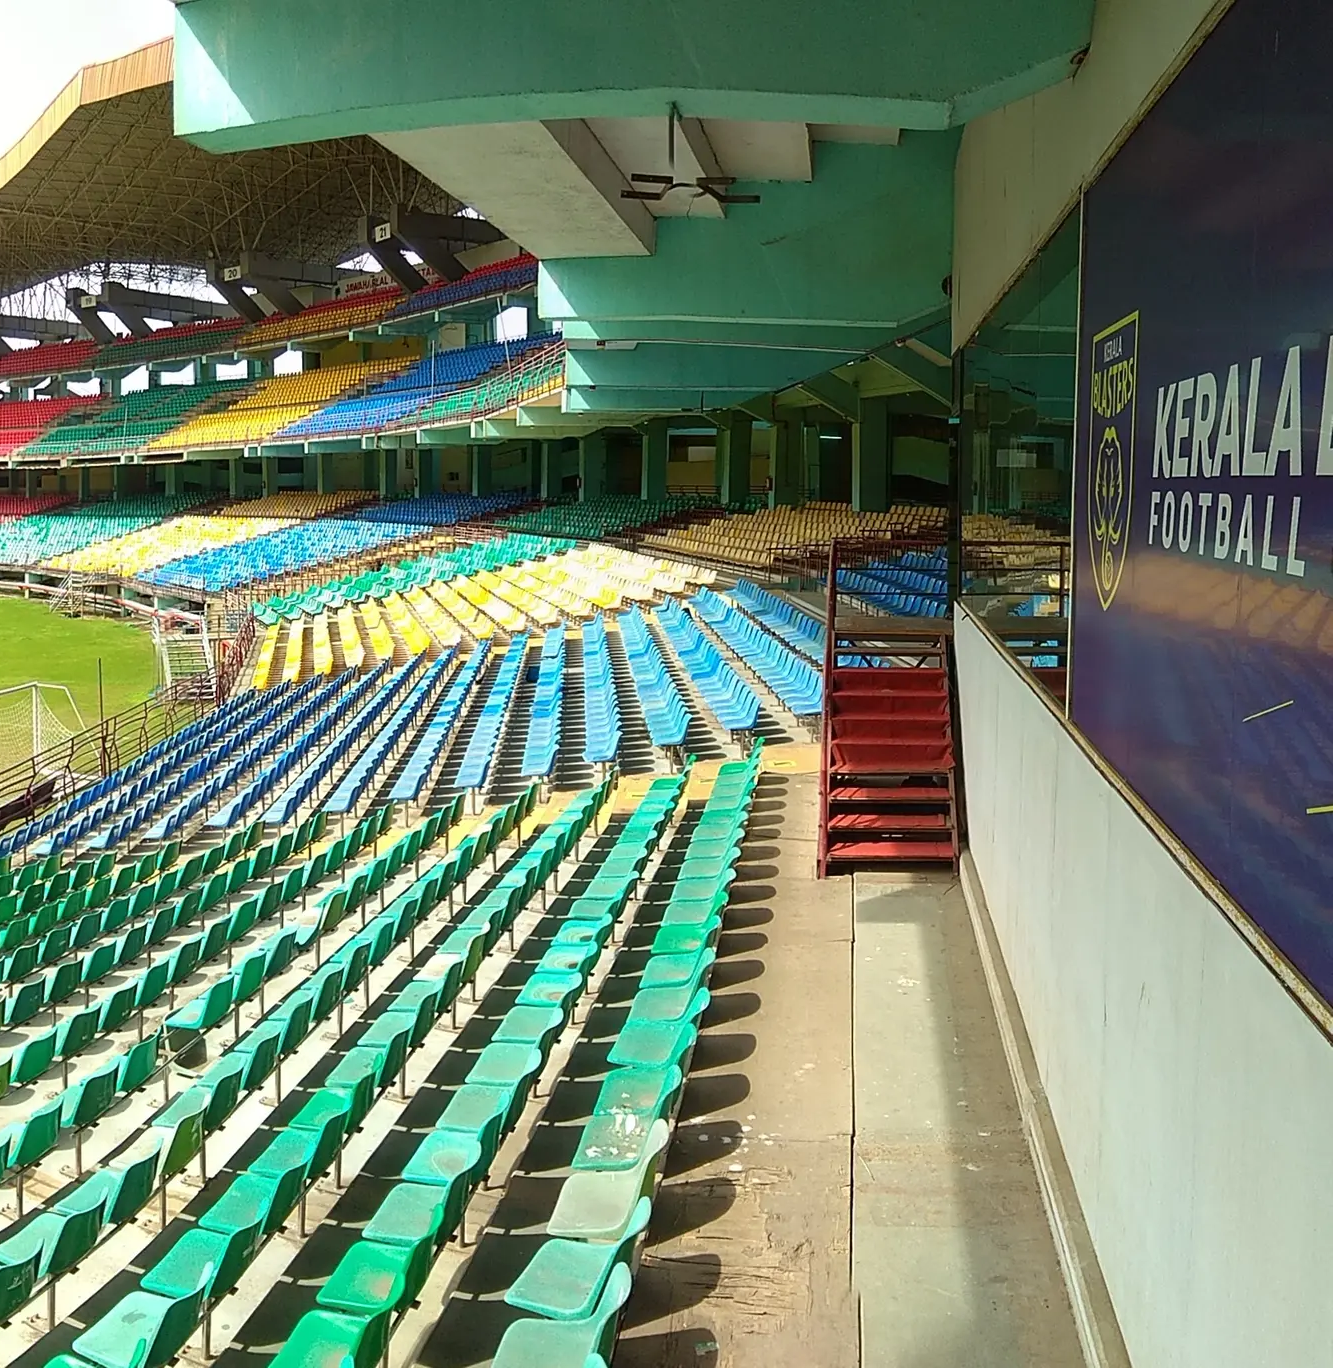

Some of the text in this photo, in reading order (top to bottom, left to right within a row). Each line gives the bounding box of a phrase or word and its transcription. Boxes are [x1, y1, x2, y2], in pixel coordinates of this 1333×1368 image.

[379, 226, 387, 238] 21
[228, 268, 237, 278] 20
[1103, 335, 1123, 363] KERALA
[1093, 357, 1133, 418] BLASTERS
[1152, 345, 1302, 478] KERALA
[1148, 490, 1305, 577] FOOTBALL
